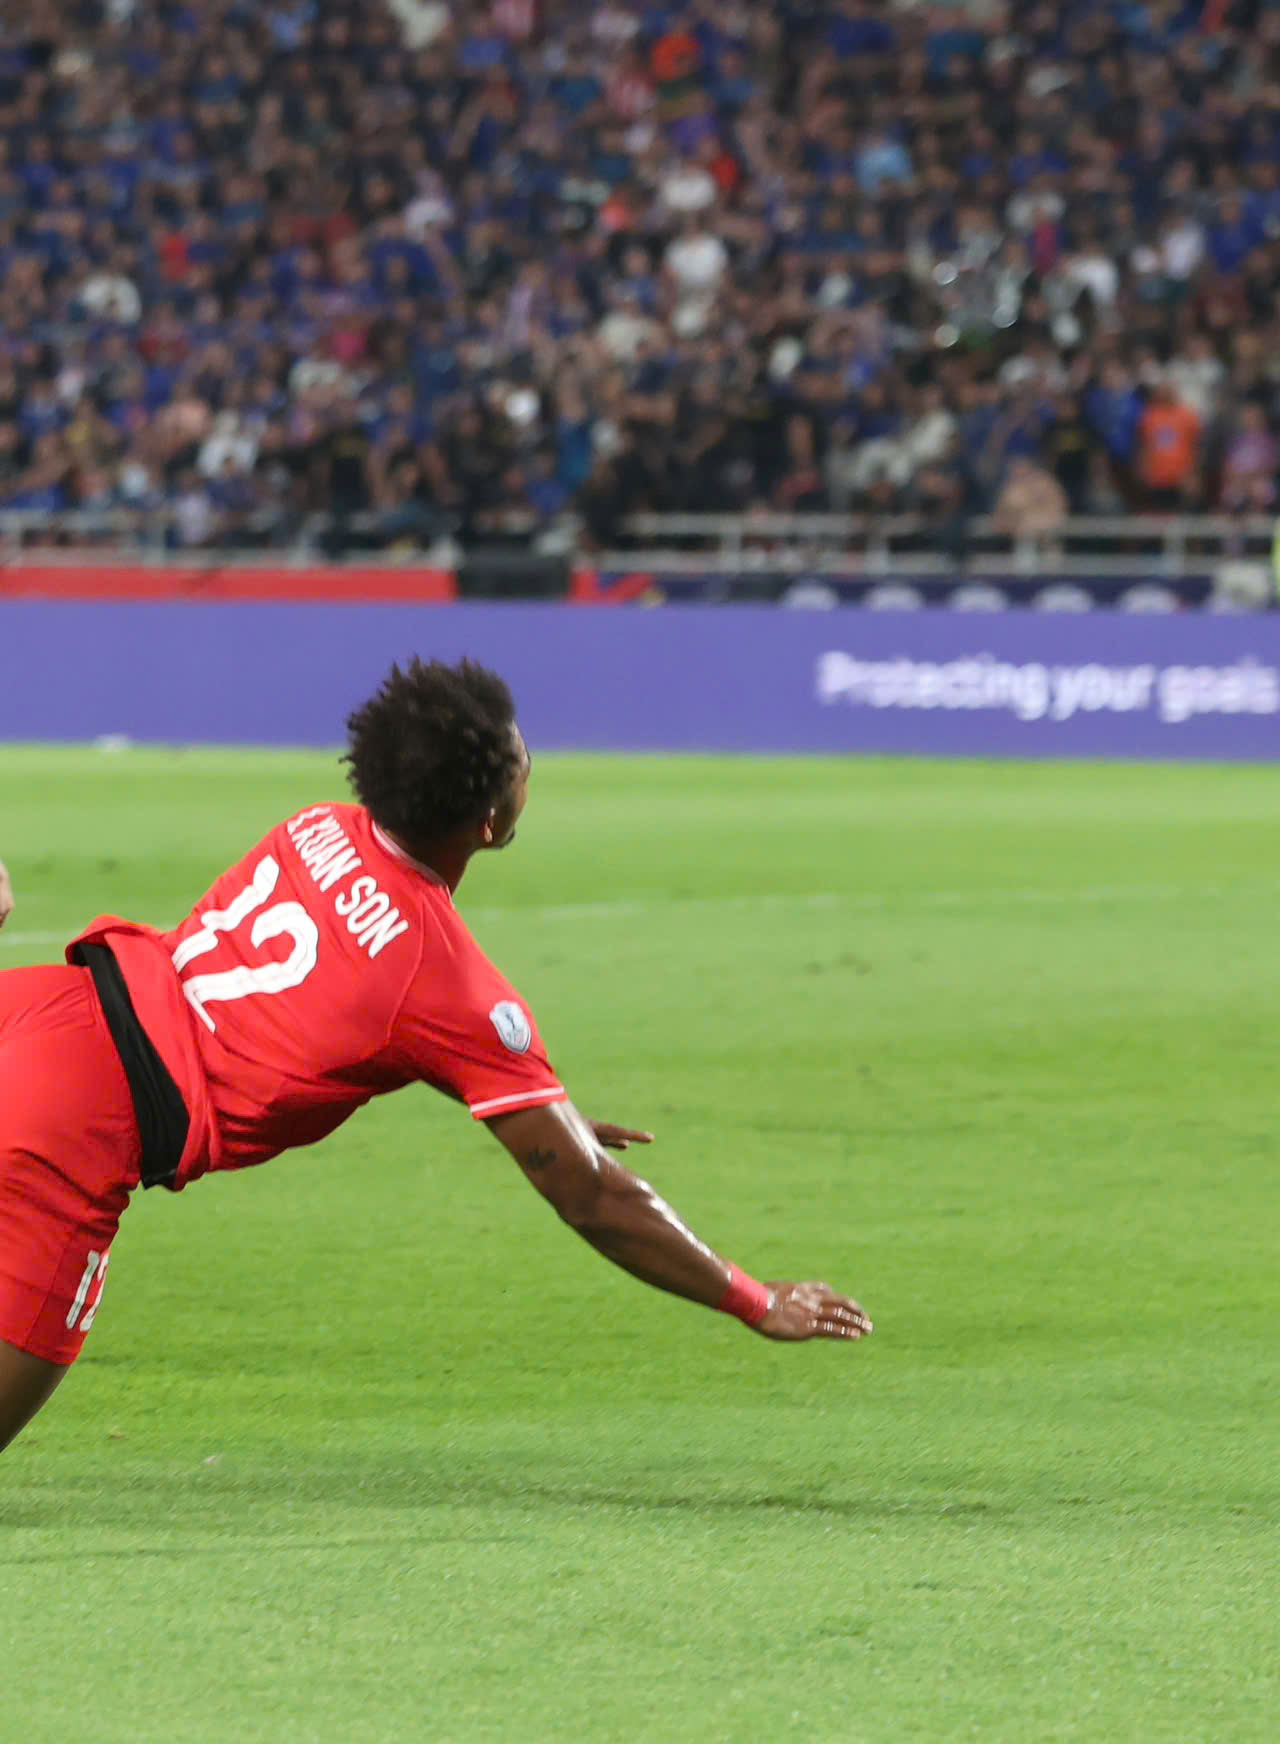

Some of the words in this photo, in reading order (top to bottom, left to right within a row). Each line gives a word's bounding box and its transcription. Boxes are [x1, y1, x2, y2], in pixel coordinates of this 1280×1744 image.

[818, 651, 1049, 721] Protecting
[1050, 663, 1156, 722] your
[171, 854, 319, 1034] 12
[334, 875, 407, 959] SON
